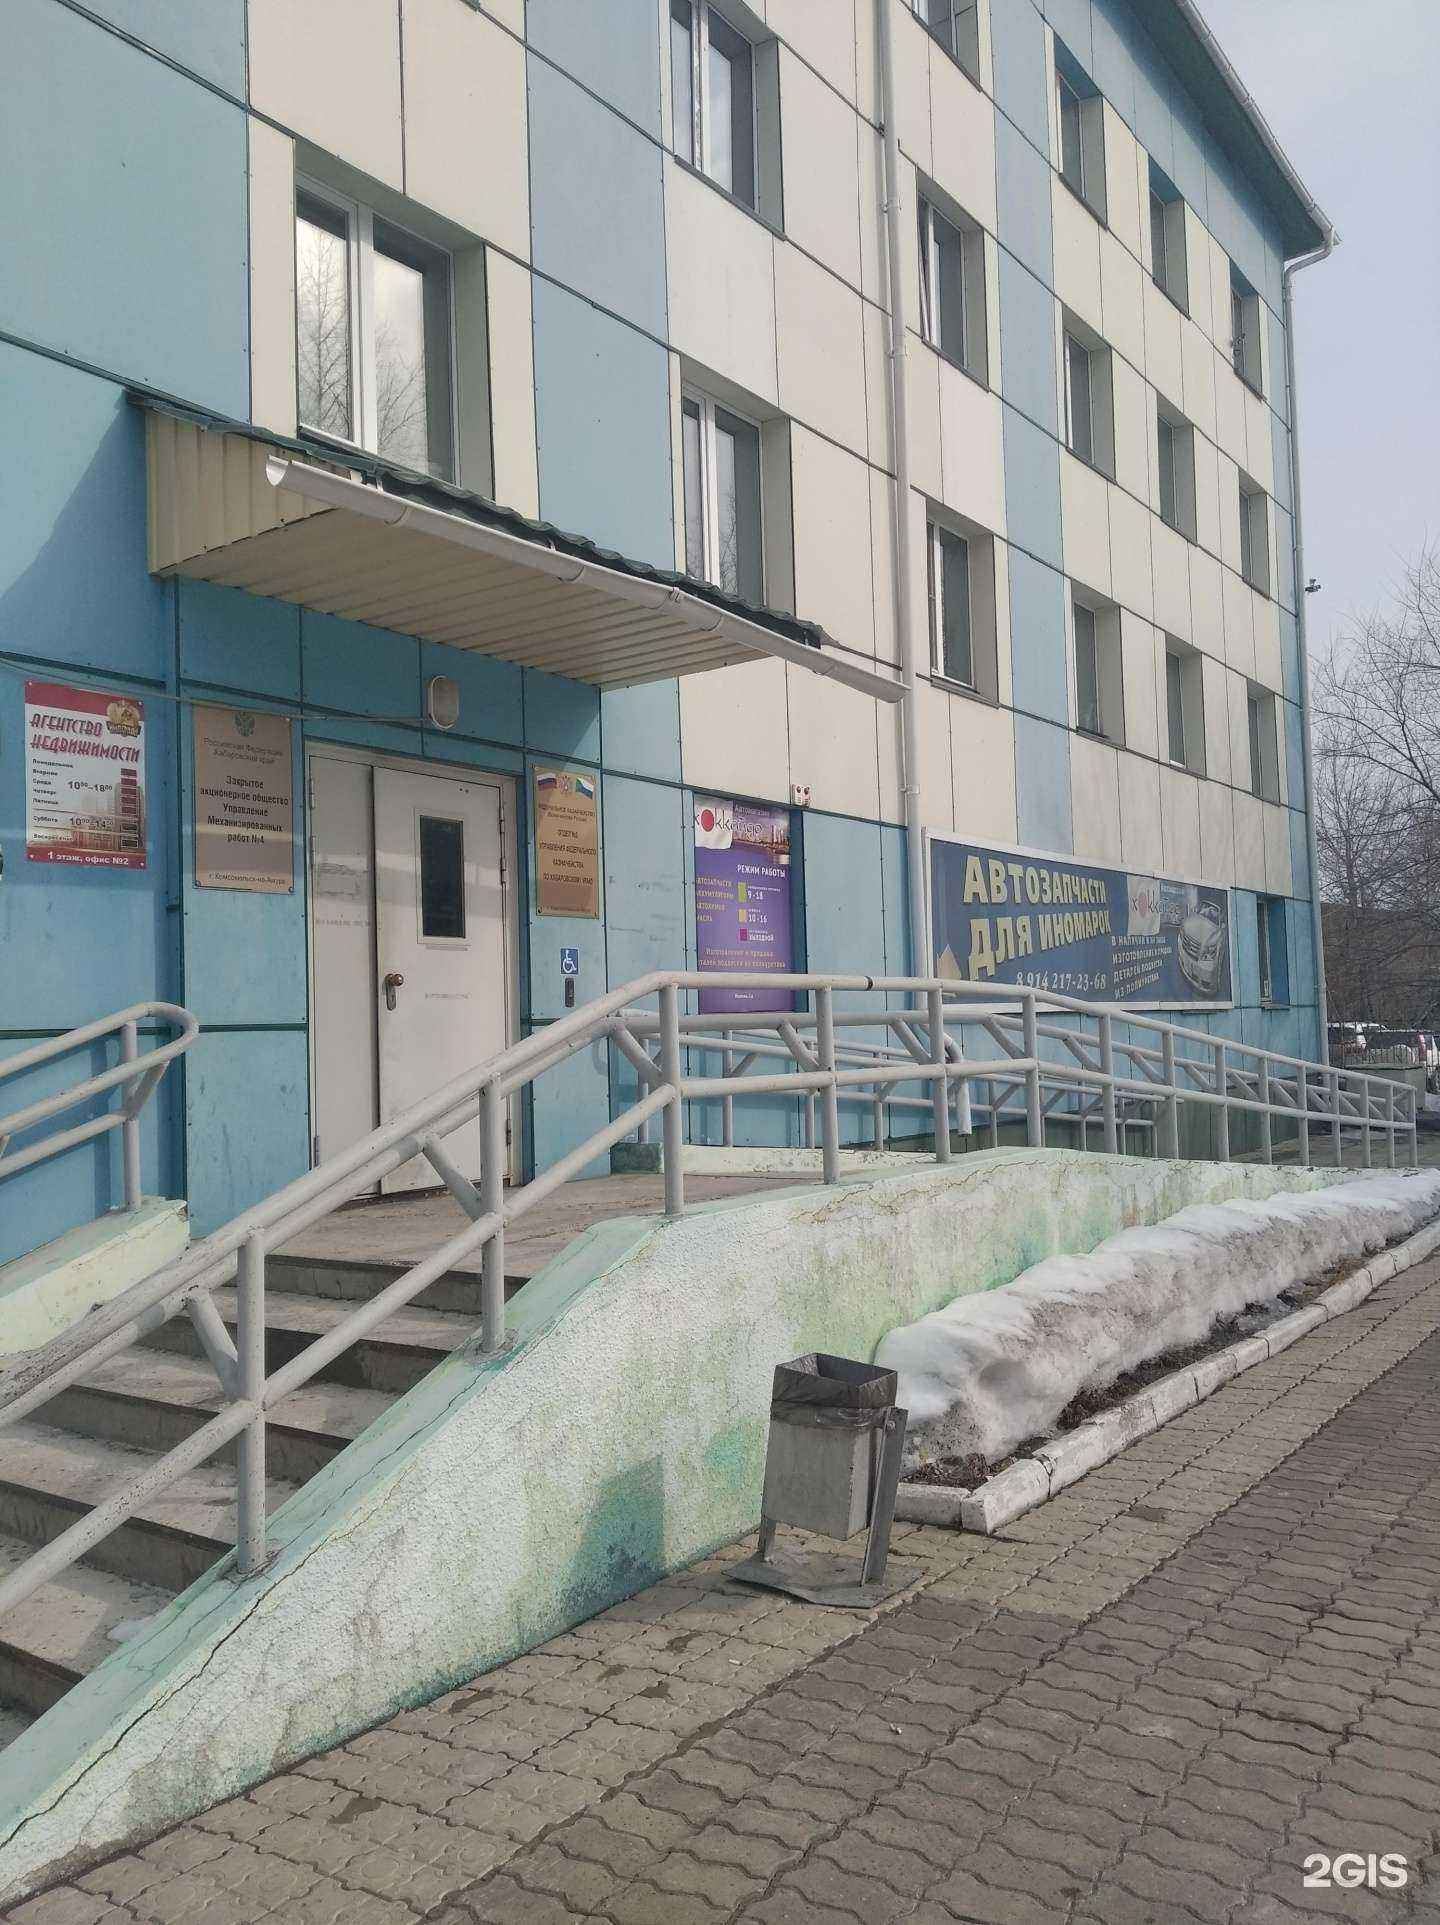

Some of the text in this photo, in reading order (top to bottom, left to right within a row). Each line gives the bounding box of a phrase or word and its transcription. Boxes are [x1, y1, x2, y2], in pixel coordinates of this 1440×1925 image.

[30, 713, 102, 736] АГЕНТСТВО
[30, 734, 140, 762] НЕДВИЖИМОСТИ
[225, 775, 264, 789] Закрытое
[200, 787, 289, 806] акционерное общество
[223, 802, 268, 817] Управление
[207, 815, 283, 832] Механизированных
[47, 850, 53, 860] 1
[85, 856, 110, 865] офис
[112, 857, 129, 866] №2
[737, 864, 786, 878] РЕЖИМ РАБОТЫ
[963, 854, 1107, 904] АВТОЗАПЧАСТИ
[968, 910, 1111, 981] ДЛЯ ИНОМАРОК
[1052, 972, 1106, 992] 217-23-68
